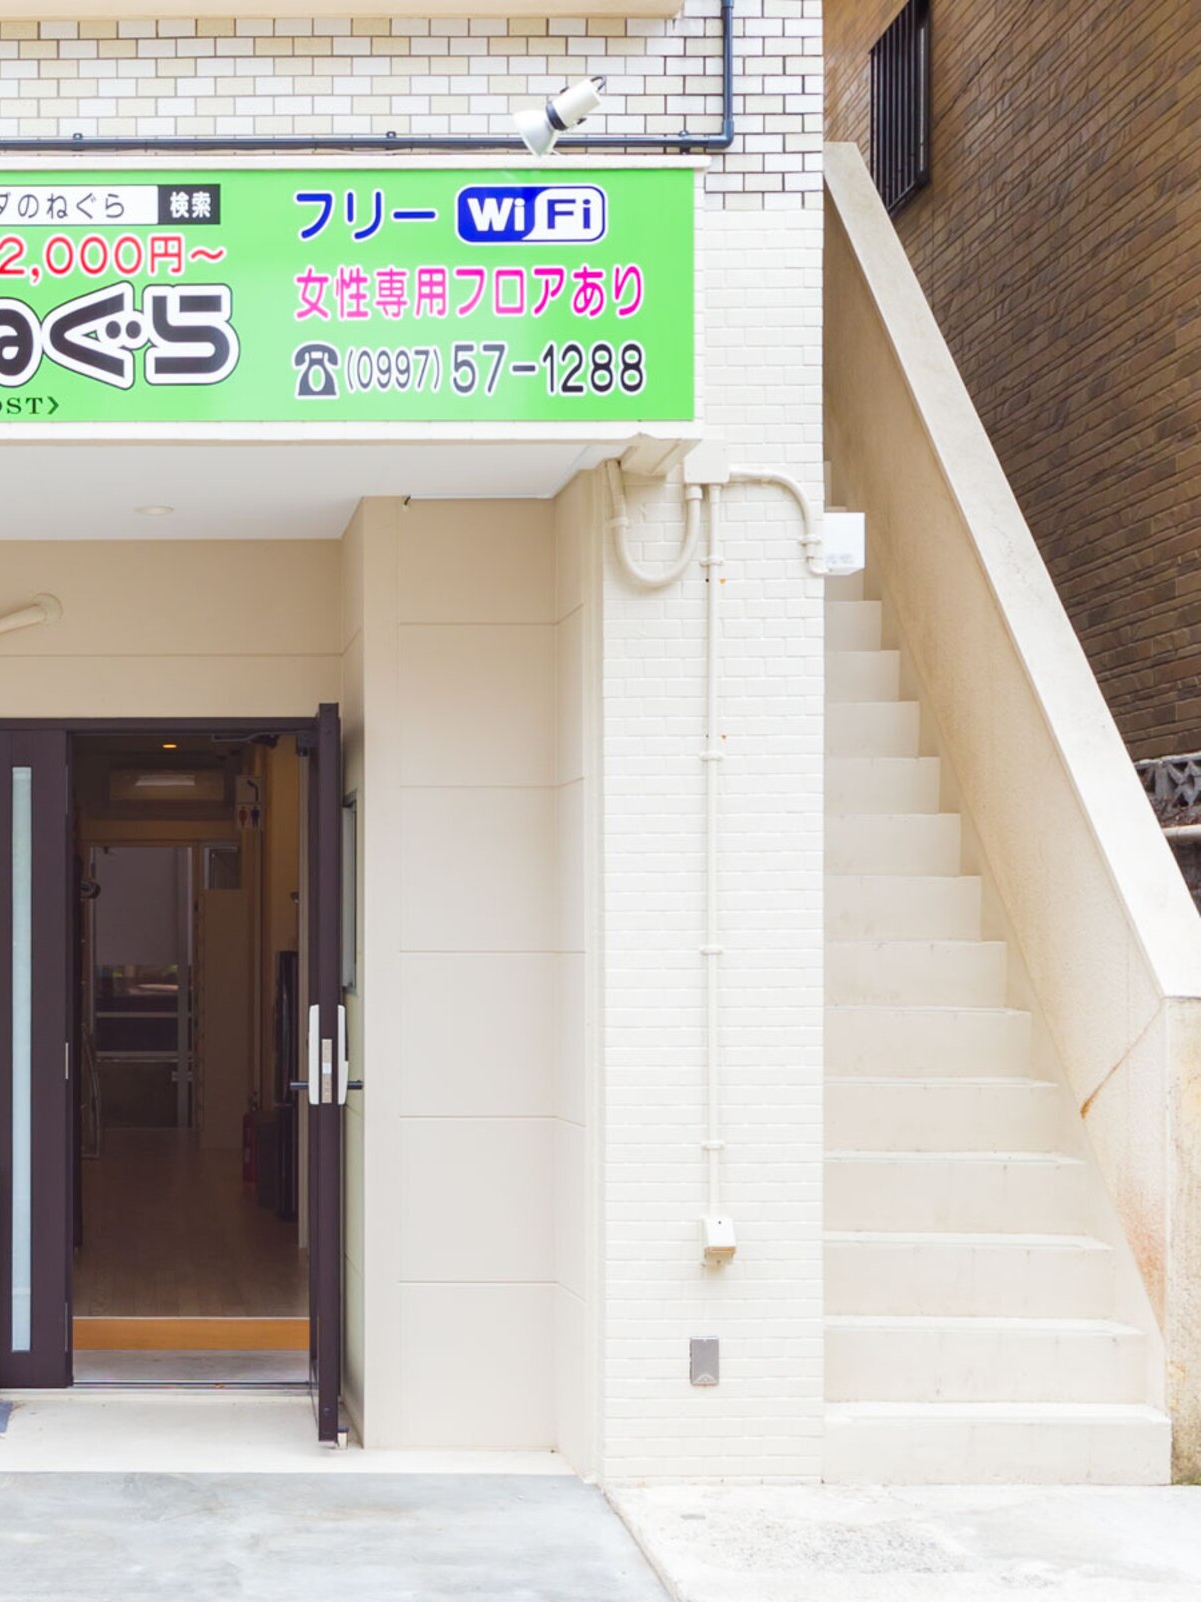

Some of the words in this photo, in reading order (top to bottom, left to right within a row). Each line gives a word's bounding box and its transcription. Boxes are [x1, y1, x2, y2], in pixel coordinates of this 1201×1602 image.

[169, 191, 212, 219] 検索
[295, 191, 436, 239] フリー
[296, 266, 643, 318] 女性専用フロアあり
